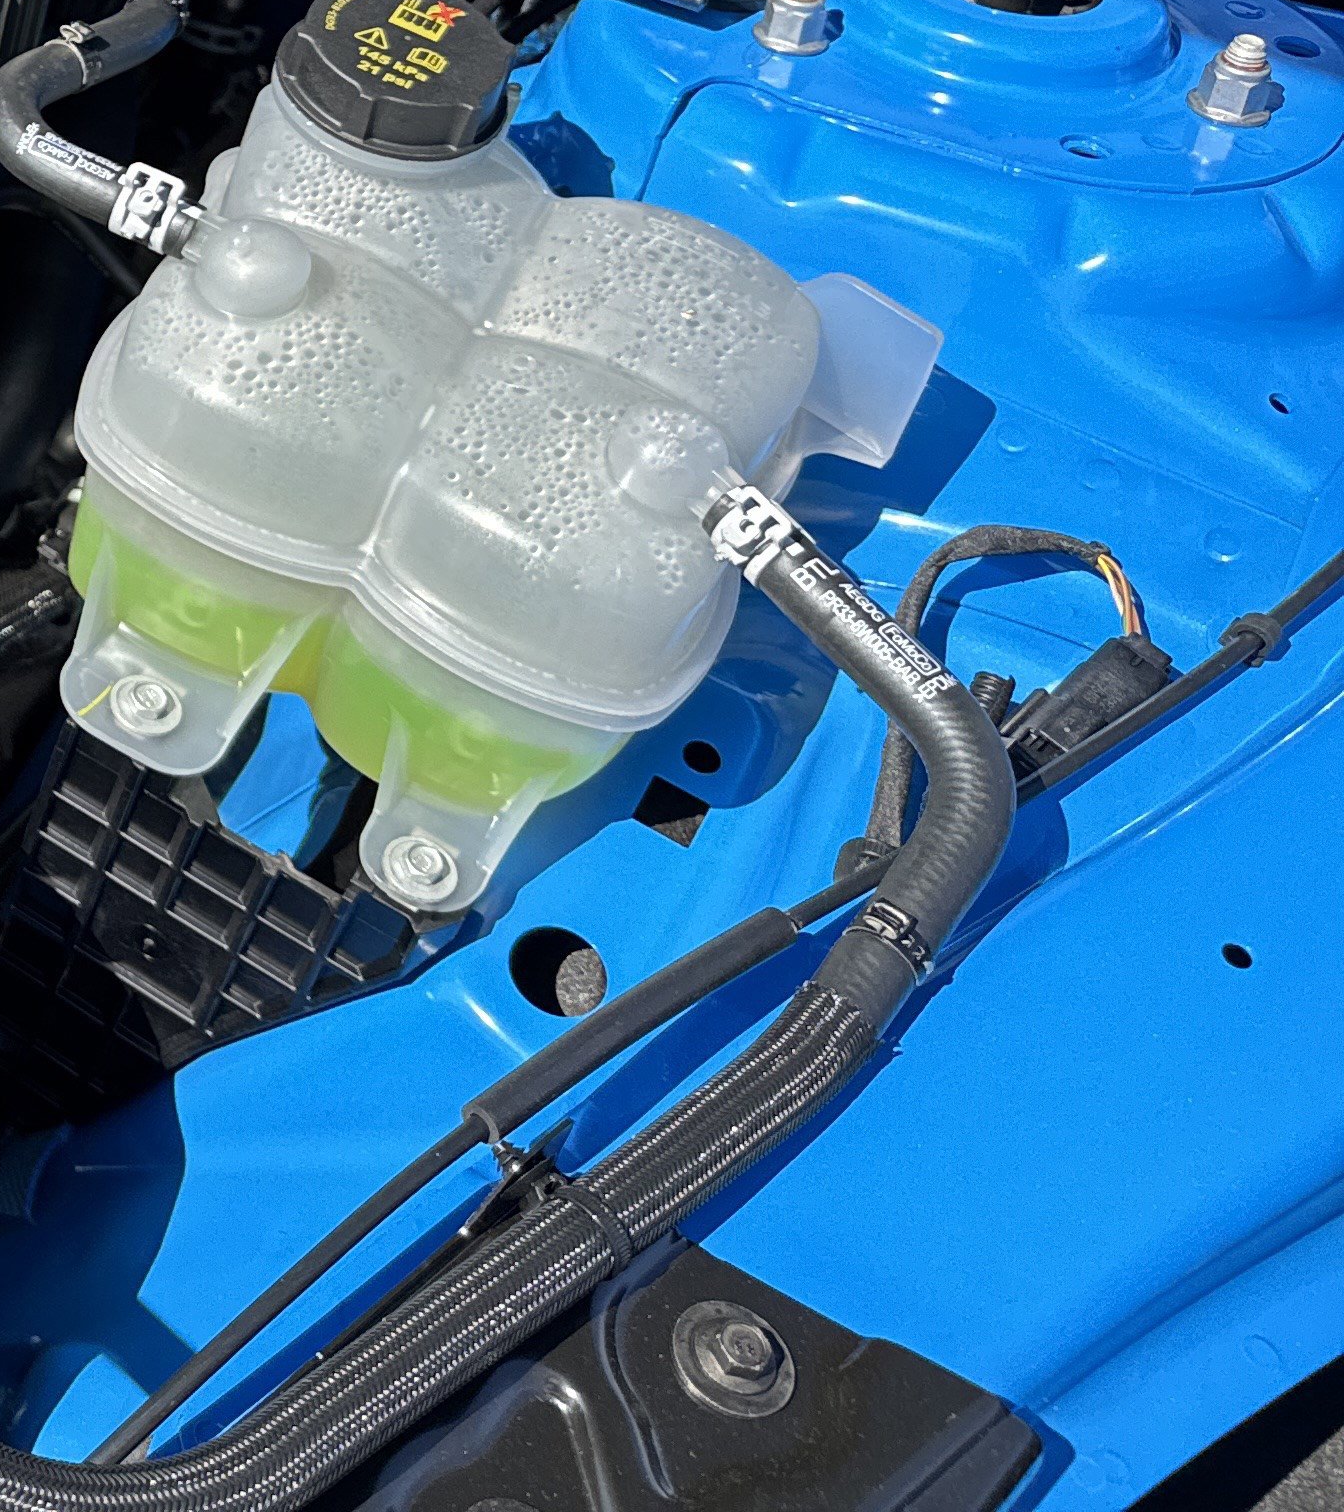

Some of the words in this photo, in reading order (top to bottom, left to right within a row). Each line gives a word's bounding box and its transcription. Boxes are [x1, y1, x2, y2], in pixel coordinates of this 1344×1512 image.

[356, 59, 381, 76] 21
[382, 75, 415, 90] psi
[358, 46, 392, 67] 145
[393, 61, 430, 83] kPa
[838, 583, 886, 623] AEGDG
[884, 626, 934, 672] FoMoCo
